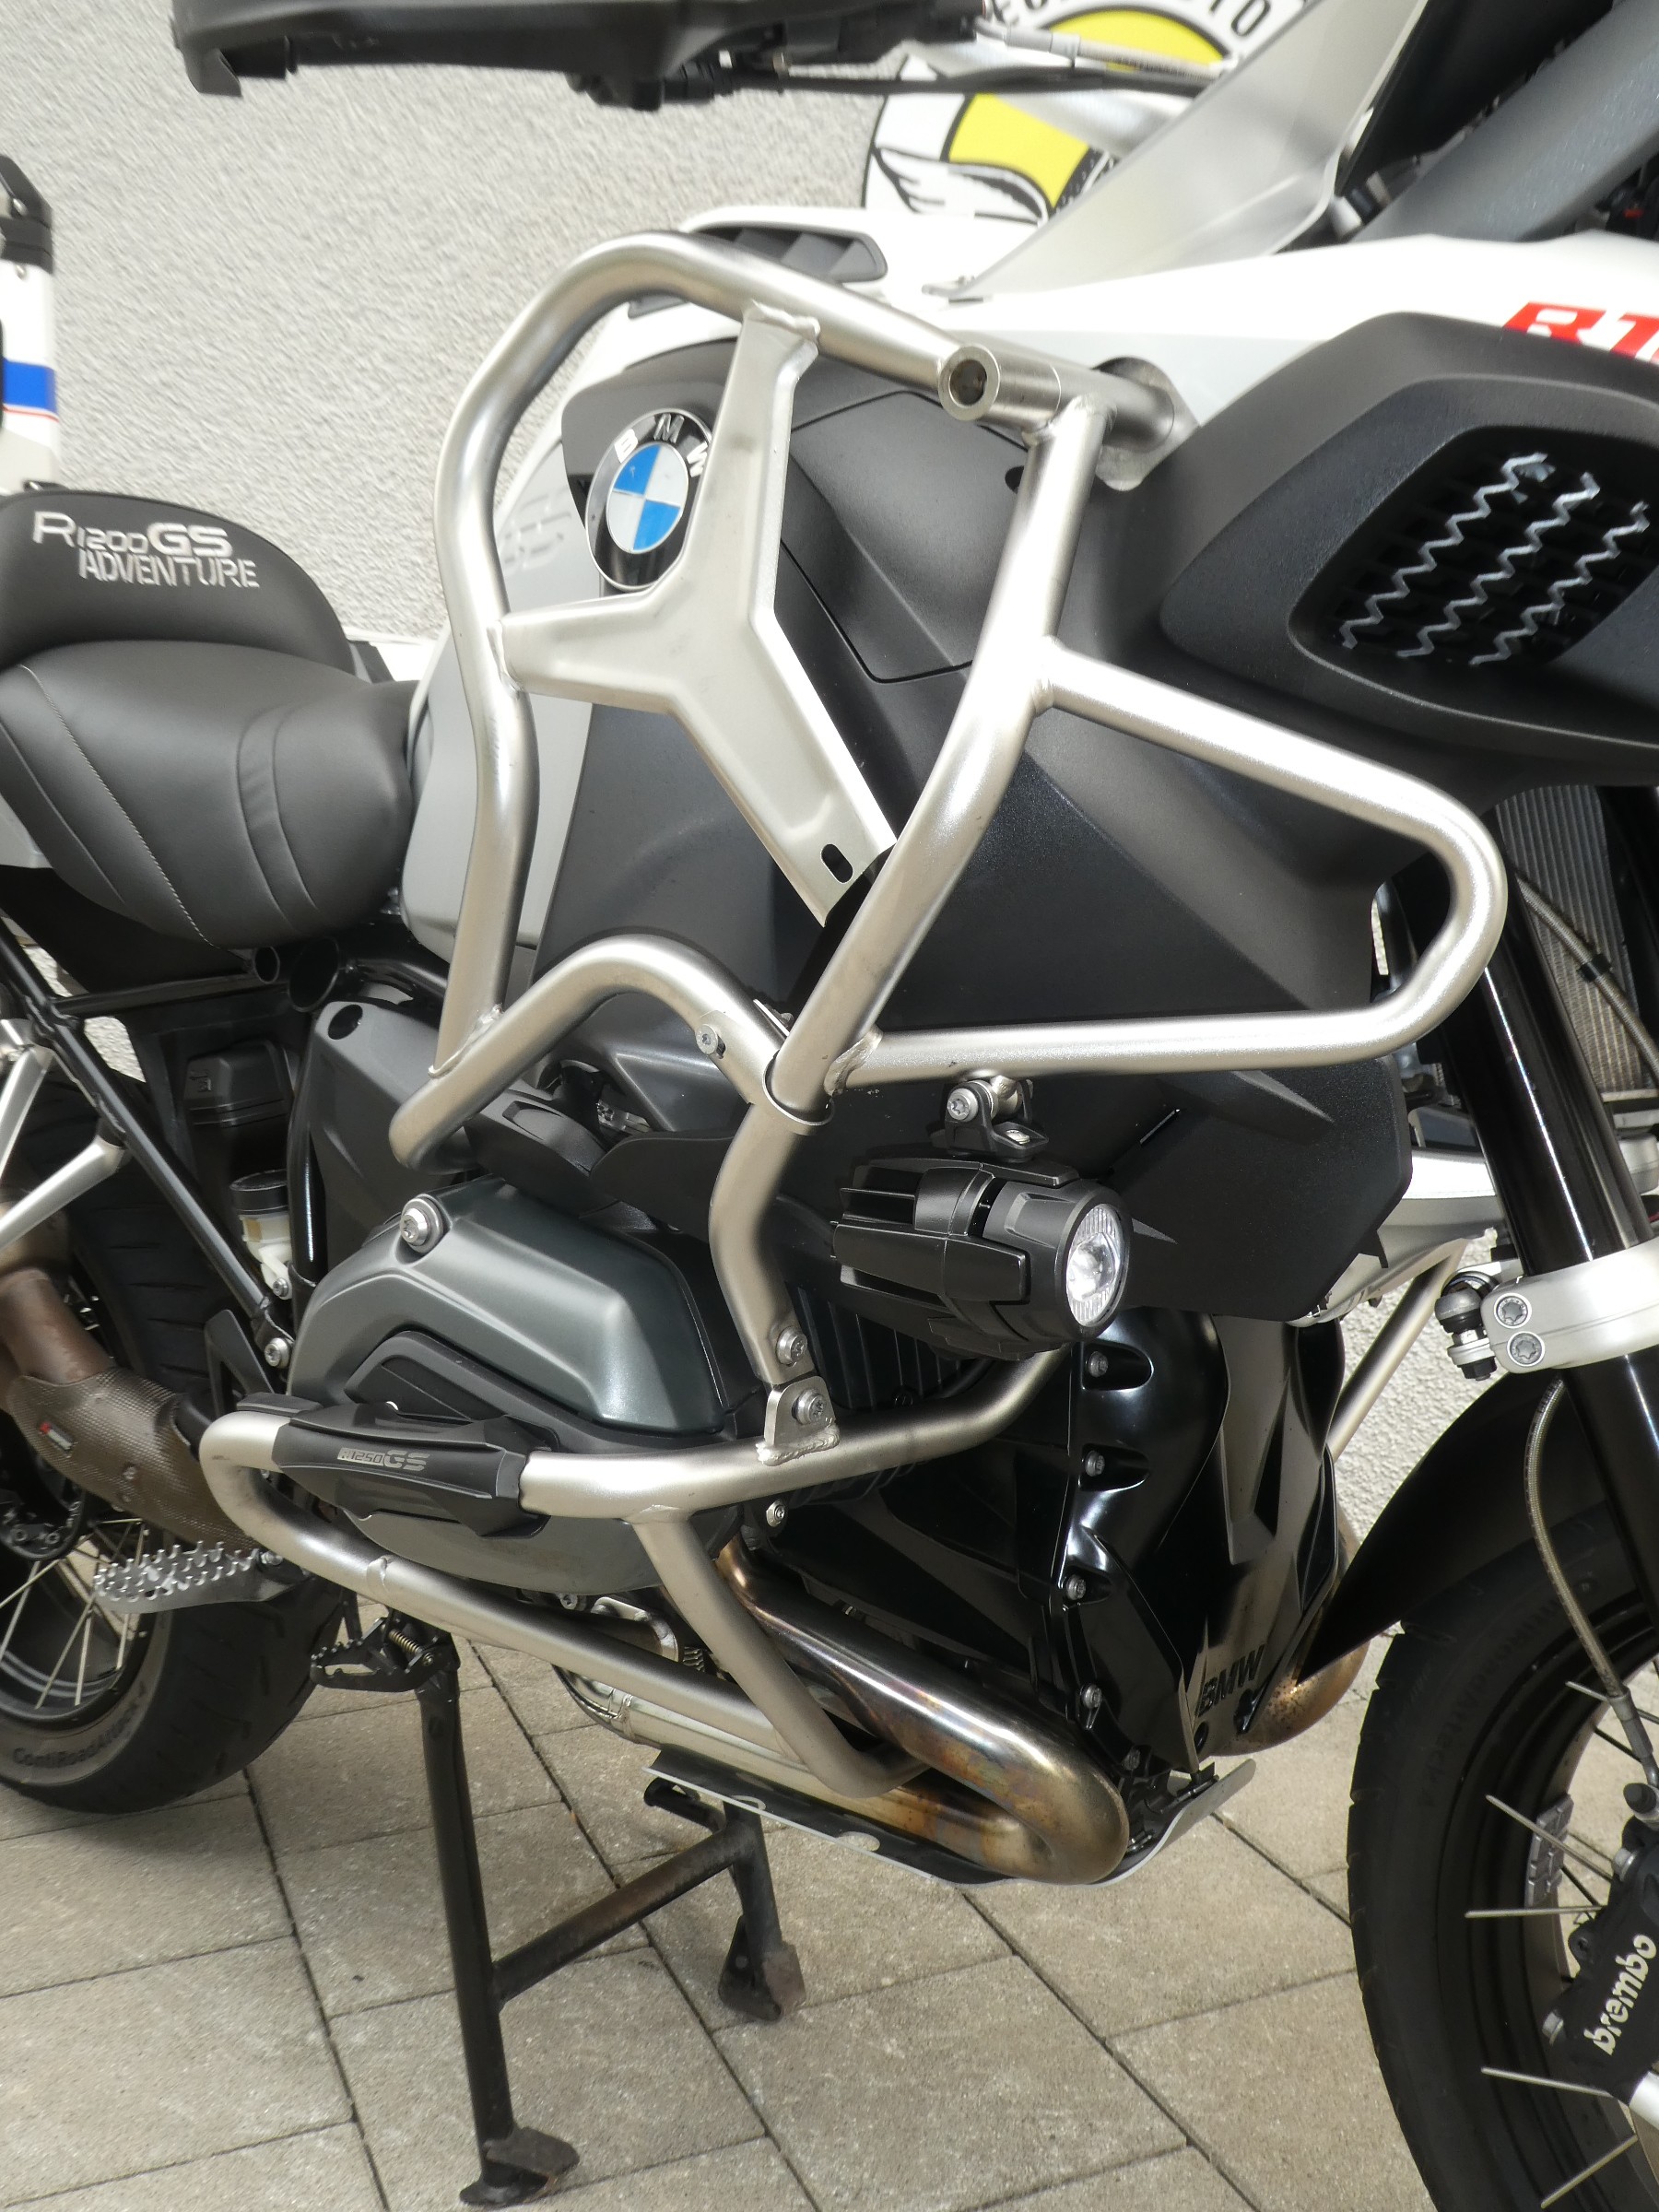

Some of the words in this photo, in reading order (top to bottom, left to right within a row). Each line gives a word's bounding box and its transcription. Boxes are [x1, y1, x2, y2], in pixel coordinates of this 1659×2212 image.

[1502, 300, 1659, 365] R1
[614, 412, 709, 478] BMW
[78, 547, 261, 588] ADVENTURE
[1197, 1643, 1265, 1718] BMW
[1583, 1934, 1657, 2056] brembo
